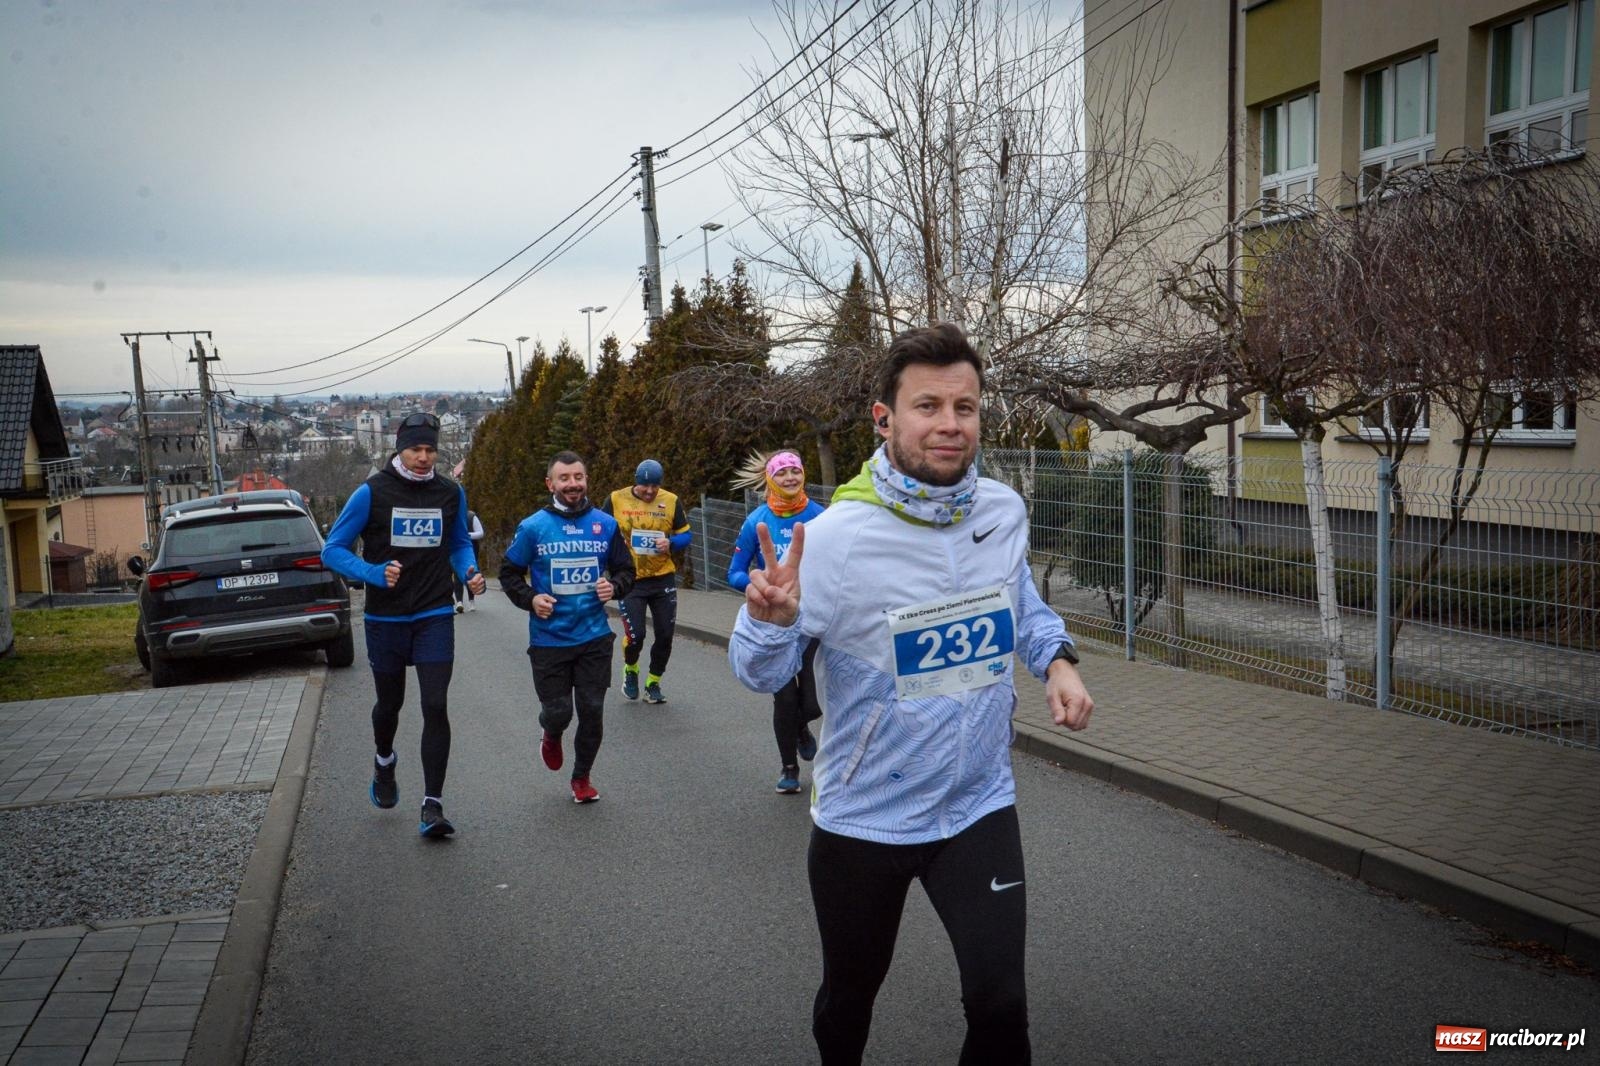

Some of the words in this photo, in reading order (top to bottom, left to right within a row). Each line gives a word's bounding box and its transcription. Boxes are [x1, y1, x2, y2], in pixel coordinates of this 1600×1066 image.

[402, 519, 434, 535] 164
[537, 540, 608, 555] RUNNERS
[224, 578, 238, 588] OP
[243, 573, 276, 587] 1239P
[560, 568, 592, 583] 166
[916, 616, 1000, 670] 232
